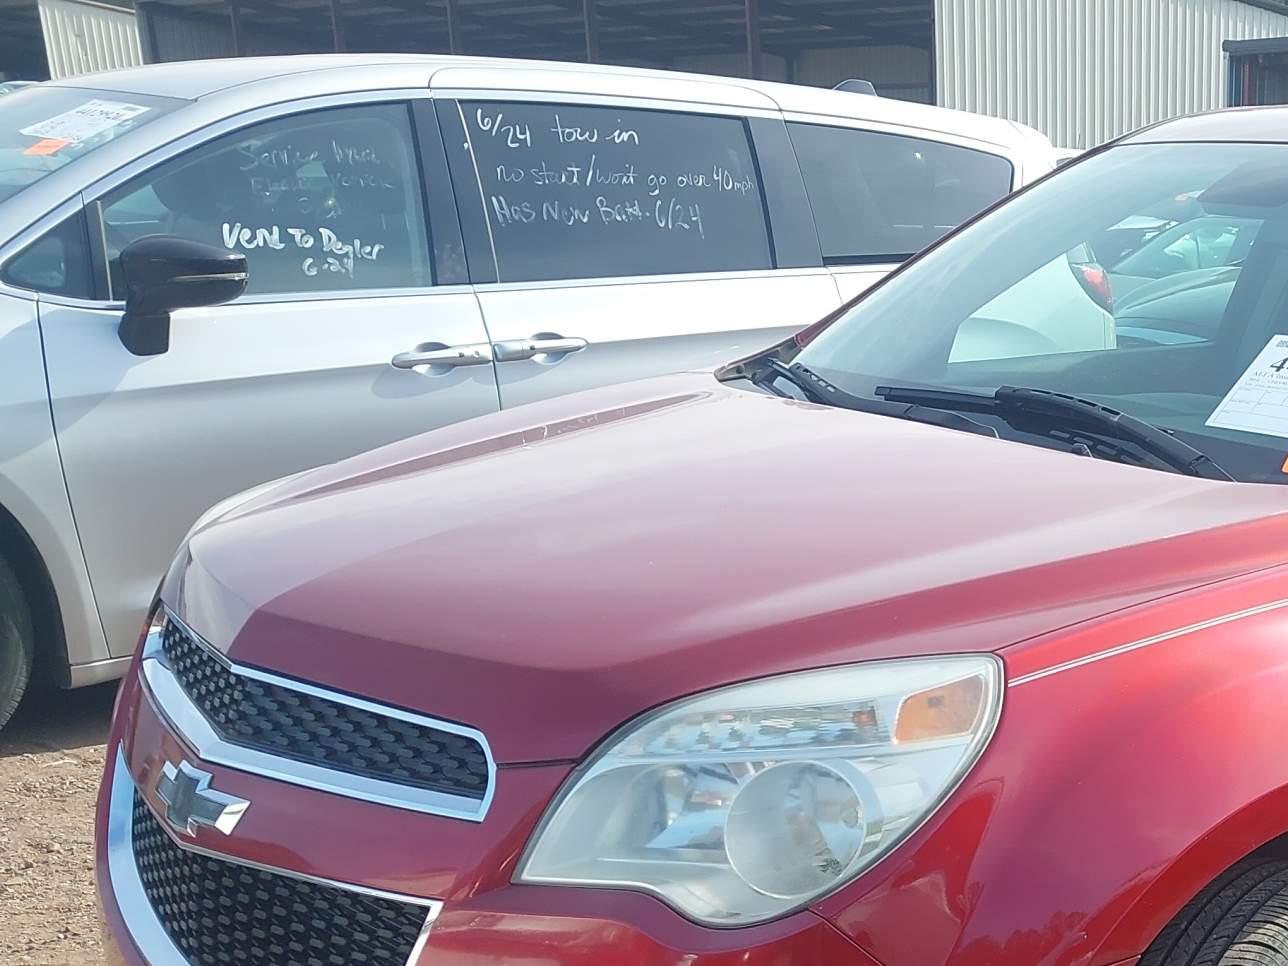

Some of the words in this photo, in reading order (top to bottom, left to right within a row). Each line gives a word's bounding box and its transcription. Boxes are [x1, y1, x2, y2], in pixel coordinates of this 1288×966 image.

[476, 108, 531, 147] 6/24
[551, 114, 598, 143] tow
[605, 119, 639, 145] in
[648, 174, 667, 195] go
[677, 173, 711, 187] over
